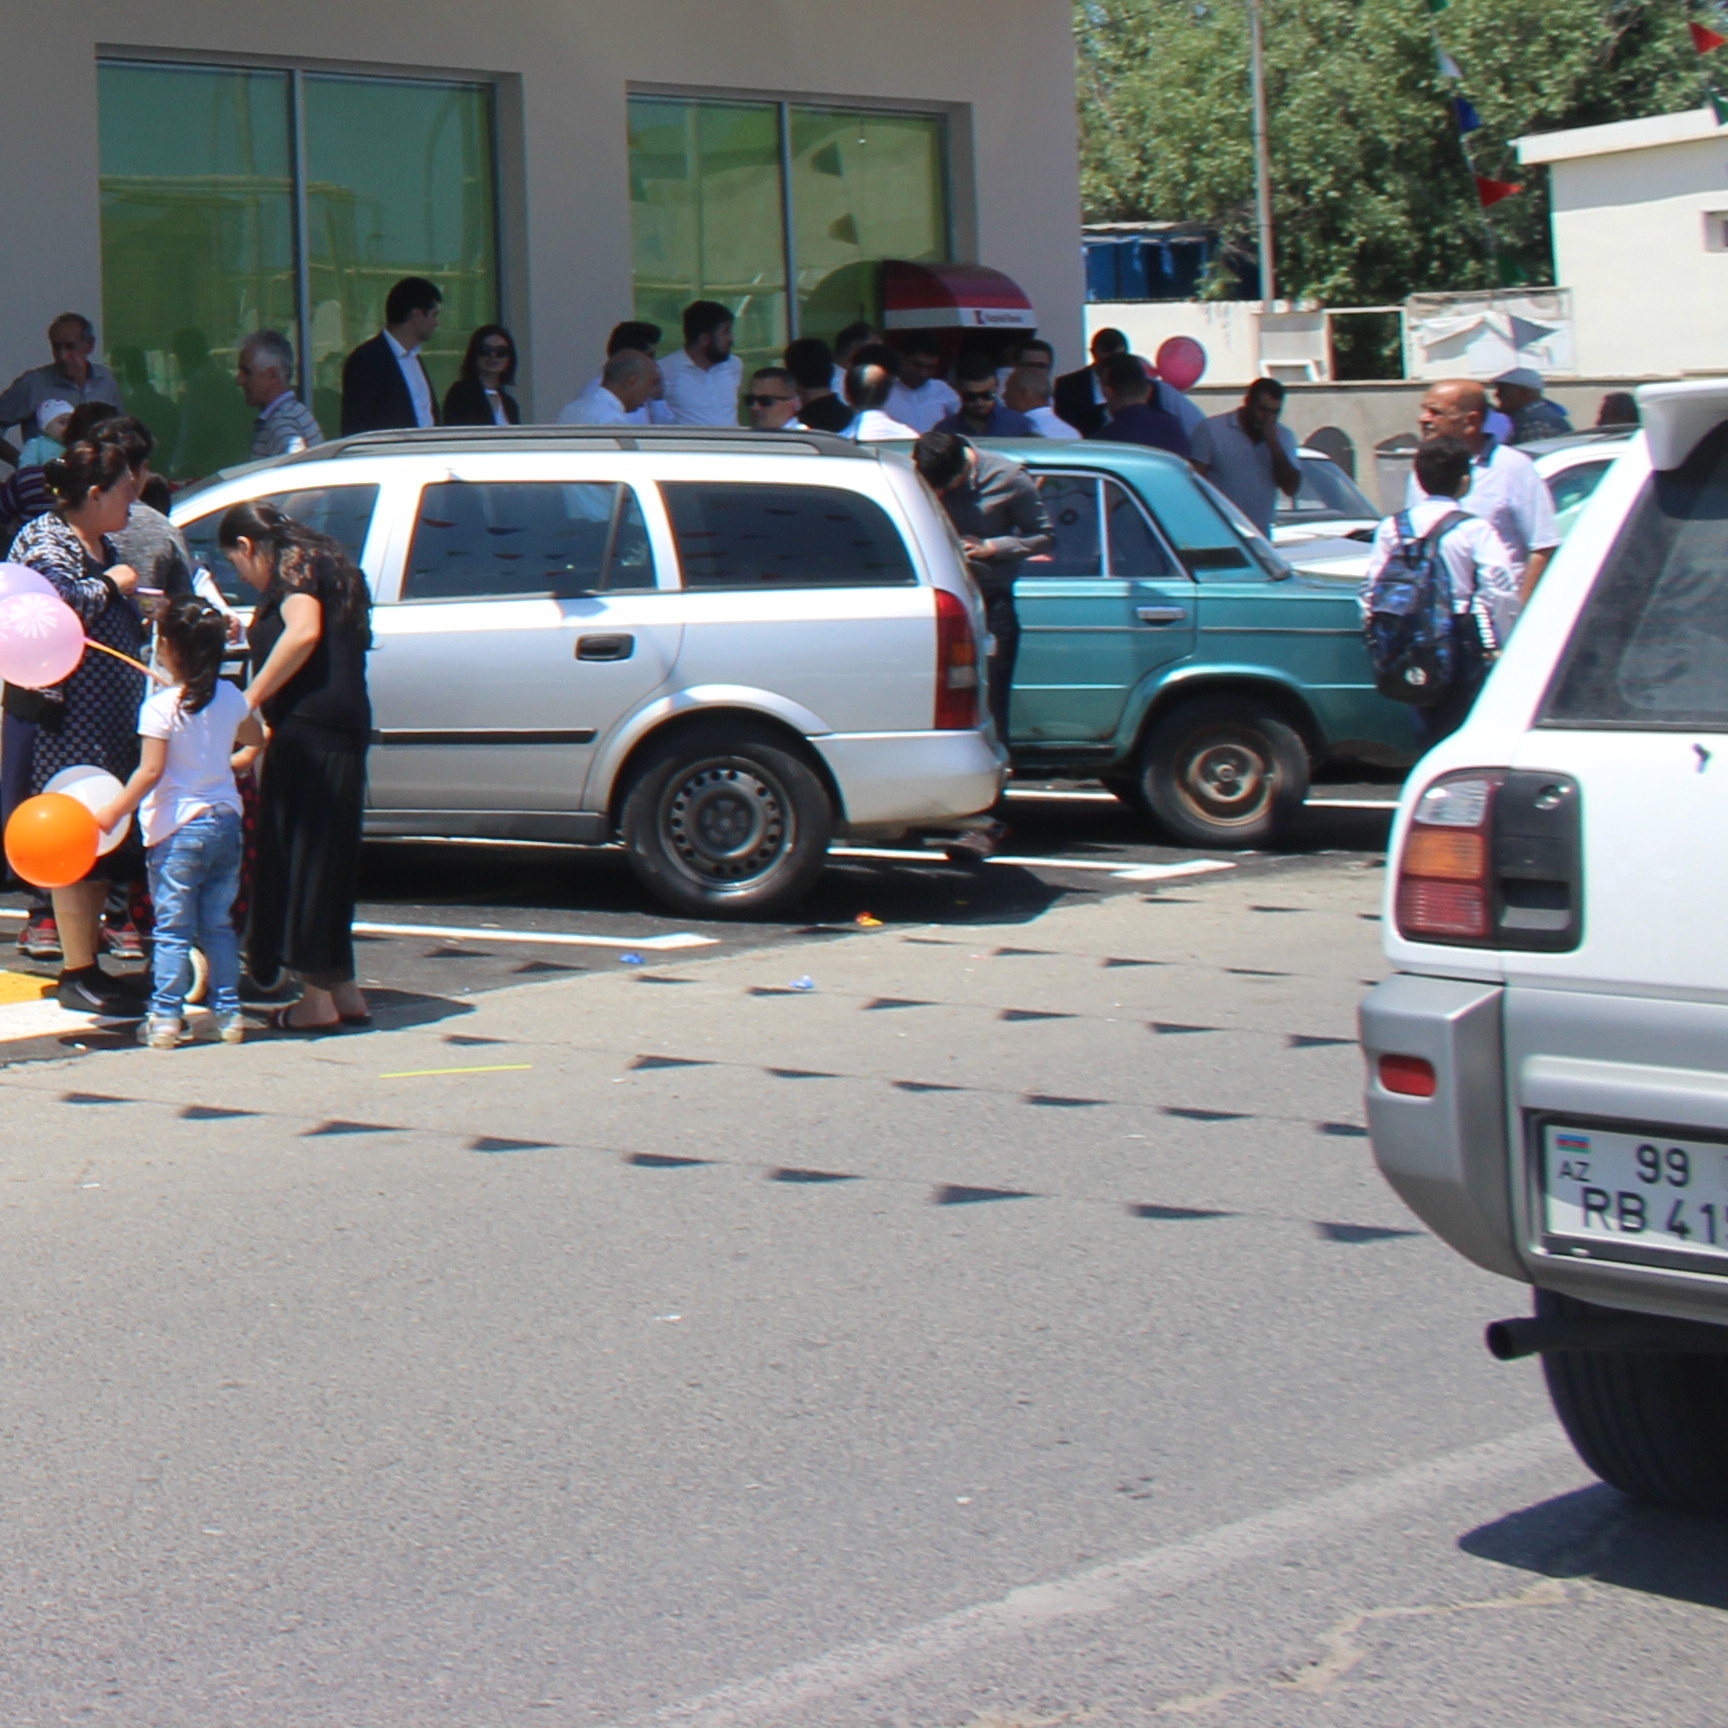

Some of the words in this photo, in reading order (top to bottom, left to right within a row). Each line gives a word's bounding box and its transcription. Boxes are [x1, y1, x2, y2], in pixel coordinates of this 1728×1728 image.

[1557, 1160, 1591, 1183] AZ
[1636, 1143, 1689, 1188] 99
[1581, 1186, 1647, 1233] RB
[1665, 1198, 1728, 1245] 41
